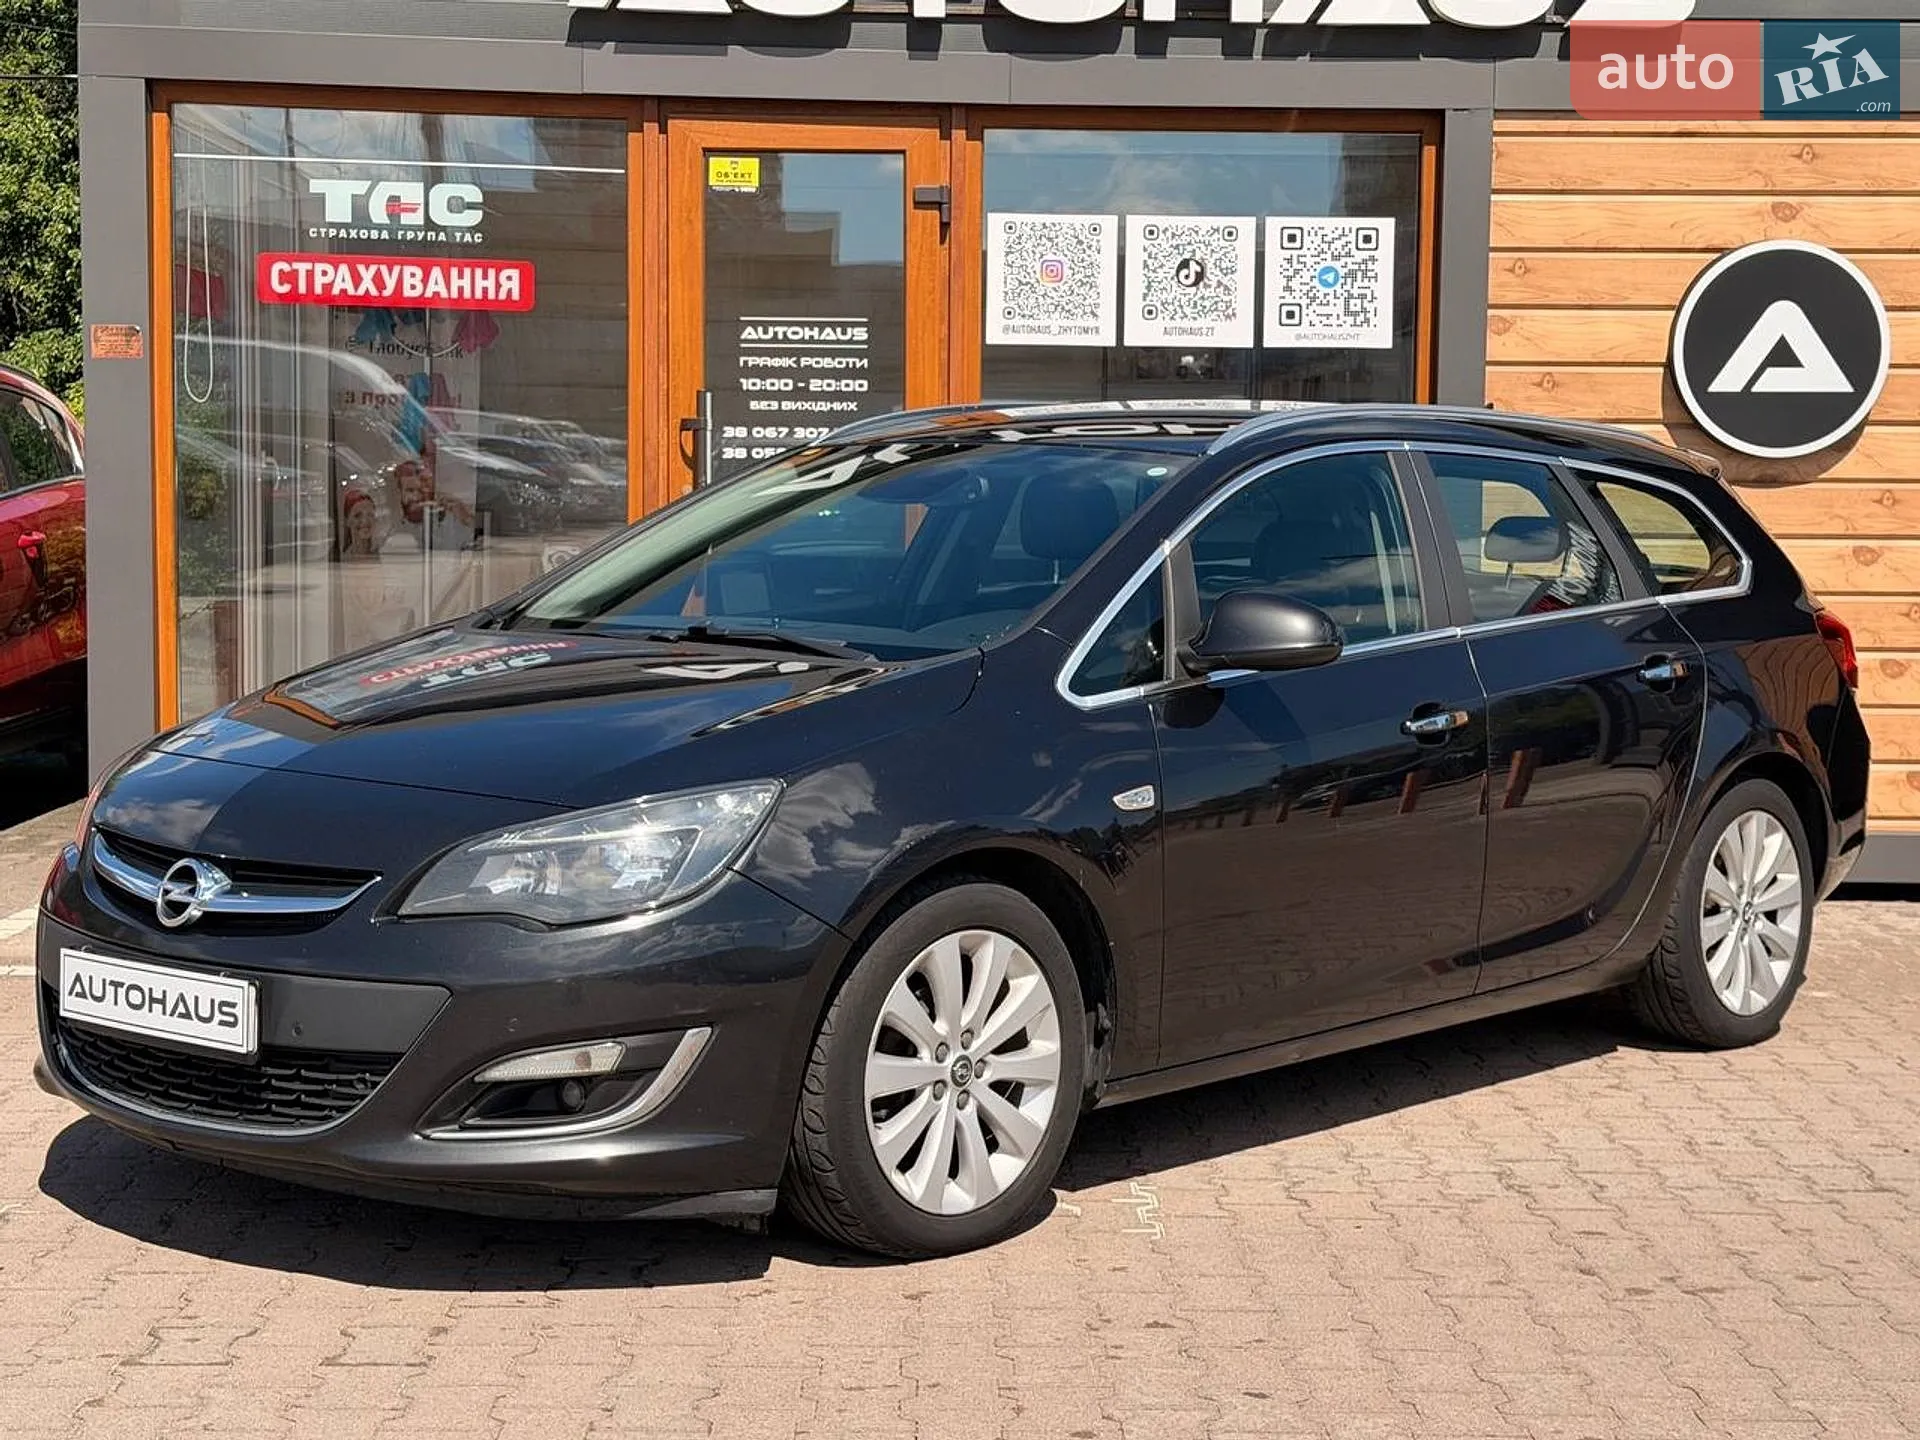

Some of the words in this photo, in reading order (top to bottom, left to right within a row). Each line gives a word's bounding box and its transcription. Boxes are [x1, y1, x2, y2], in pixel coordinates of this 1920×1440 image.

[309, 228, 390, 240] СТРАХОВА
[398, 230, 447, 242] ГРУПА
[454, 232, 483, 243] ТАС
[270, 260, 521, 301] СТРАХУВАННЯ
[740, 325, 869, 341] AUTOHAUS
[739, 356, 798, 369] ГРАФІК
[800, 357, 869, 369] РОБОТИ
[739, 378, 794, 392] 10:00
[809, 379, 869, 392] 20:00
[750, 400, 779, 411] БЕЗ
[781, 401, 859, 413] ВИХІДНИХ
[722, 426, 748, 438] 38
[751, 426, 790, 439] 067
[721, 447, 748, 459] 38
[67, 972, 239, 1029] AUTOHAUS
